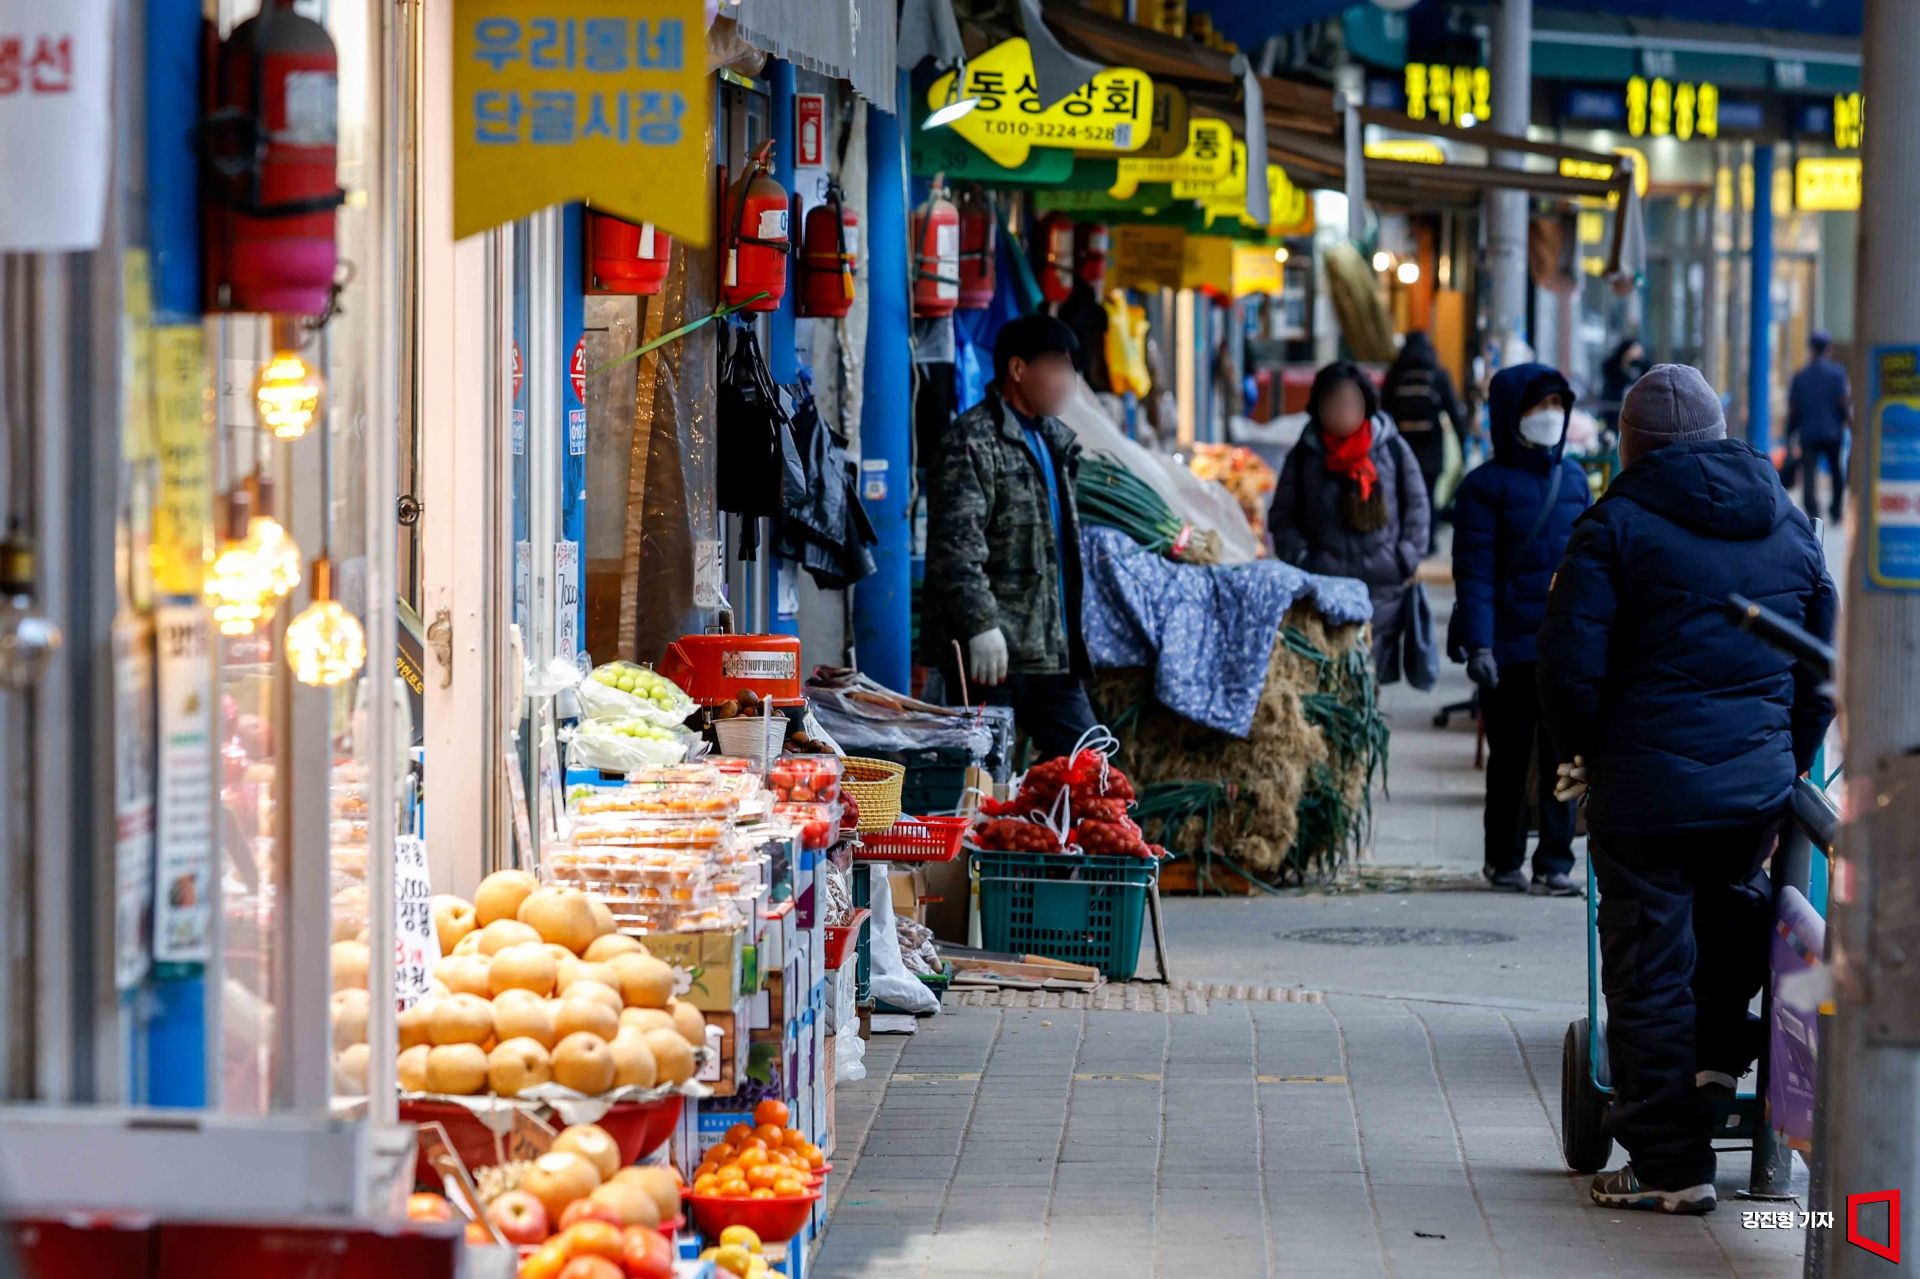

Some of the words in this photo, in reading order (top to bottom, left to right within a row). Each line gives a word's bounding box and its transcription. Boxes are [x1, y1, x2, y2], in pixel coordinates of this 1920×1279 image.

[474, 17, 684, 72] 우리동네
[474, 91, 686, 144] 단골시장
[984, 119, 1117, 141] T.010-3224-528
[558, 573, 577, 609] 7000
